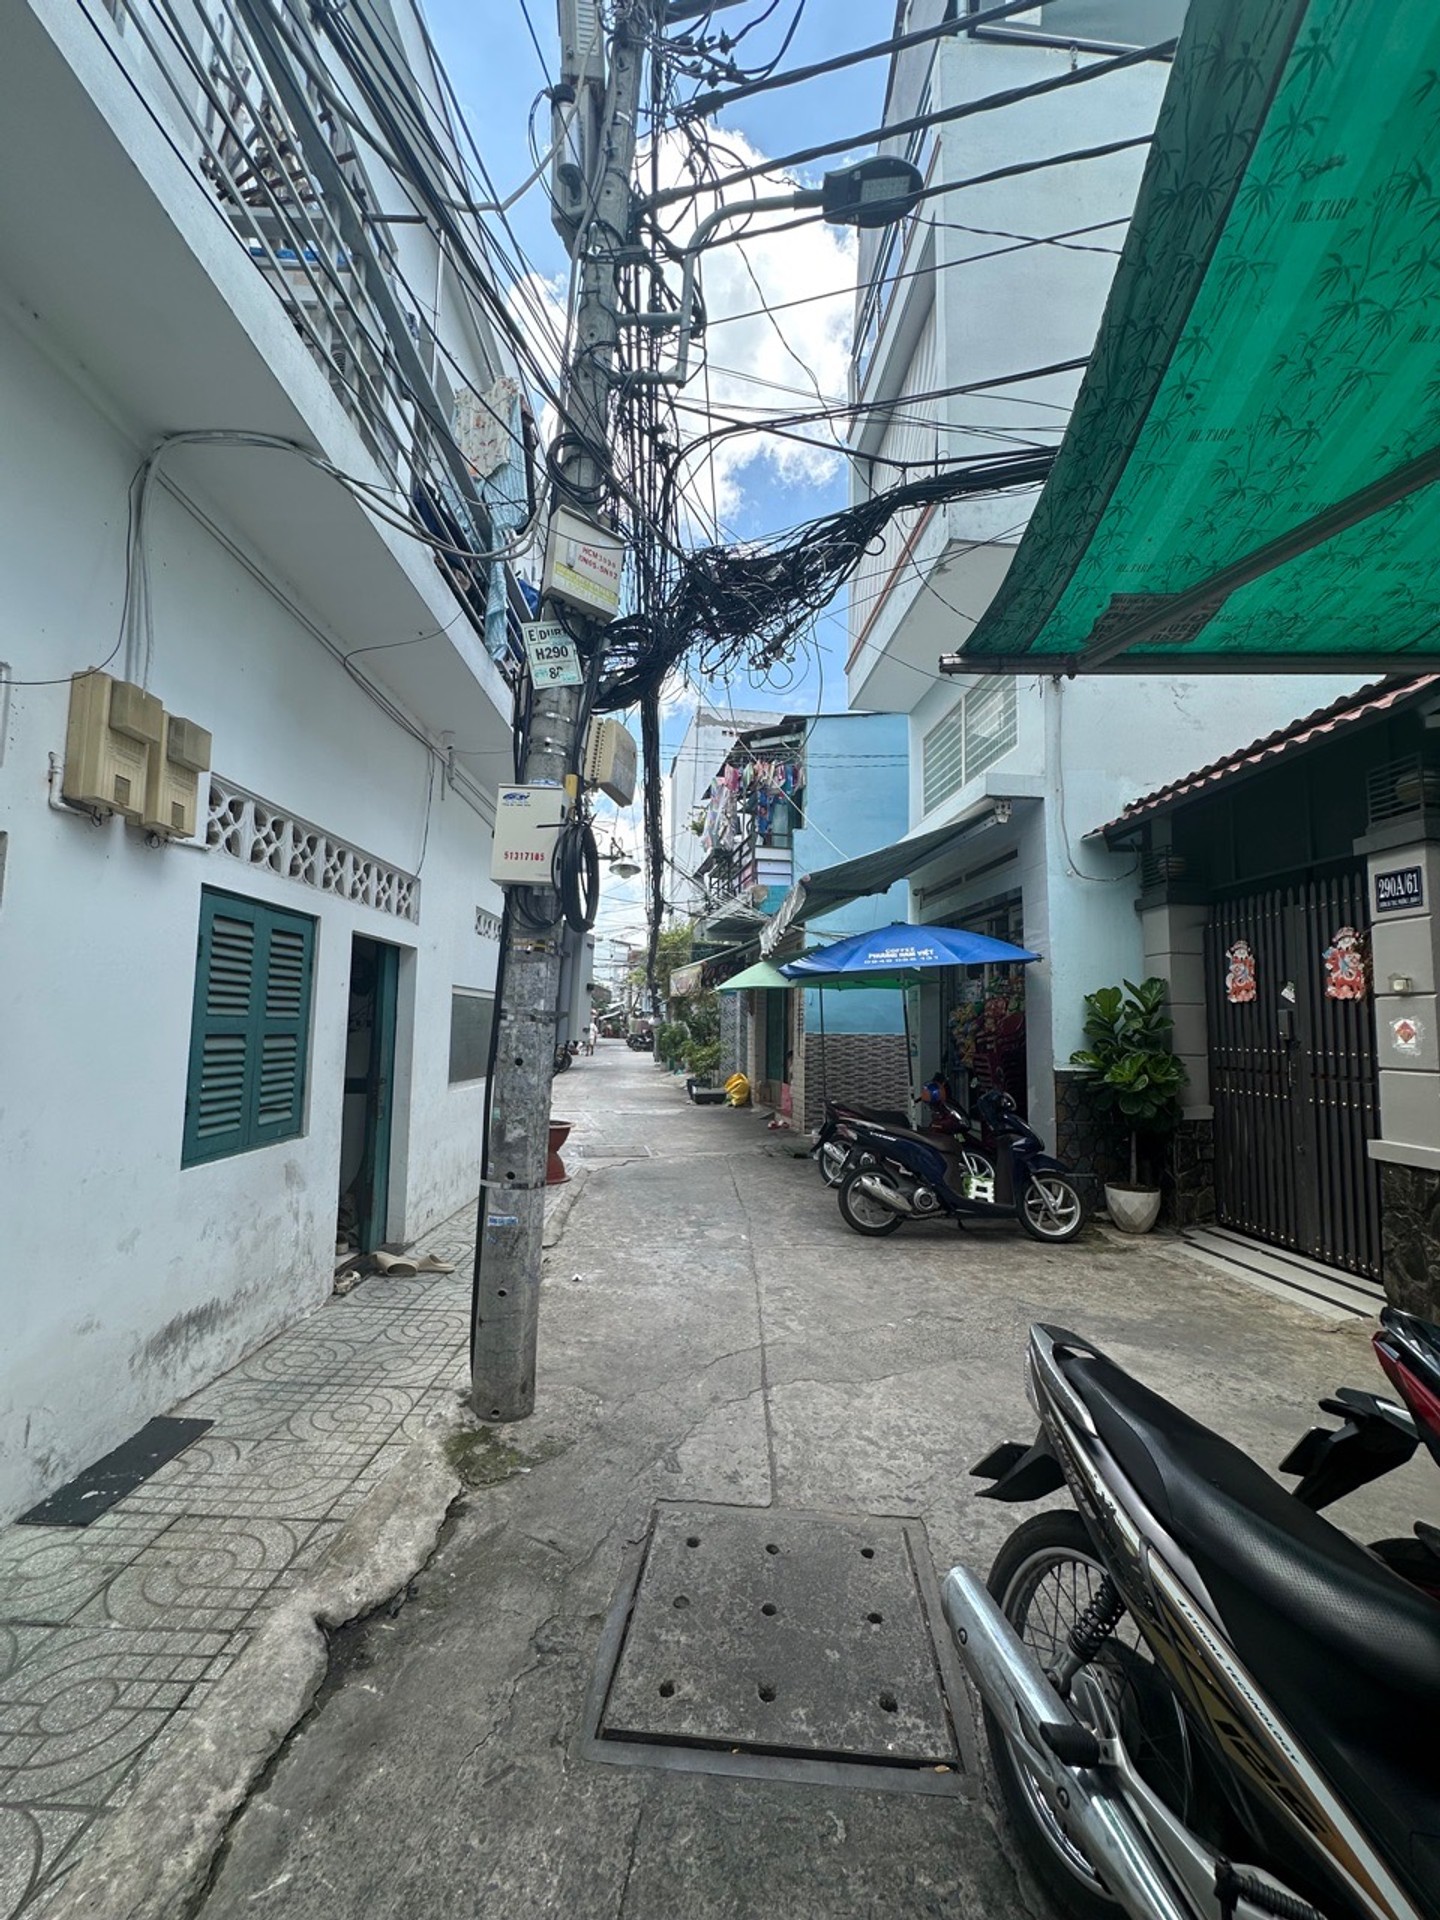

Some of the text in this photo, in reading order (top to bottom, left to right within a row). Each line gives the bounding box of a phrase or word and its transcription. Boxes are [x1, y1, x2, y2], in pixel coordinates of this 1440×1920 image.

[528, 629, 536, 641] E
[535, 645, 568, 660] H290
[1379, 873, 1419, 898] 290A/61
[1185, 1611, 1225, 1661] STROKE
[1226, 1665, 1300, 1765] TECHNOLOGY
